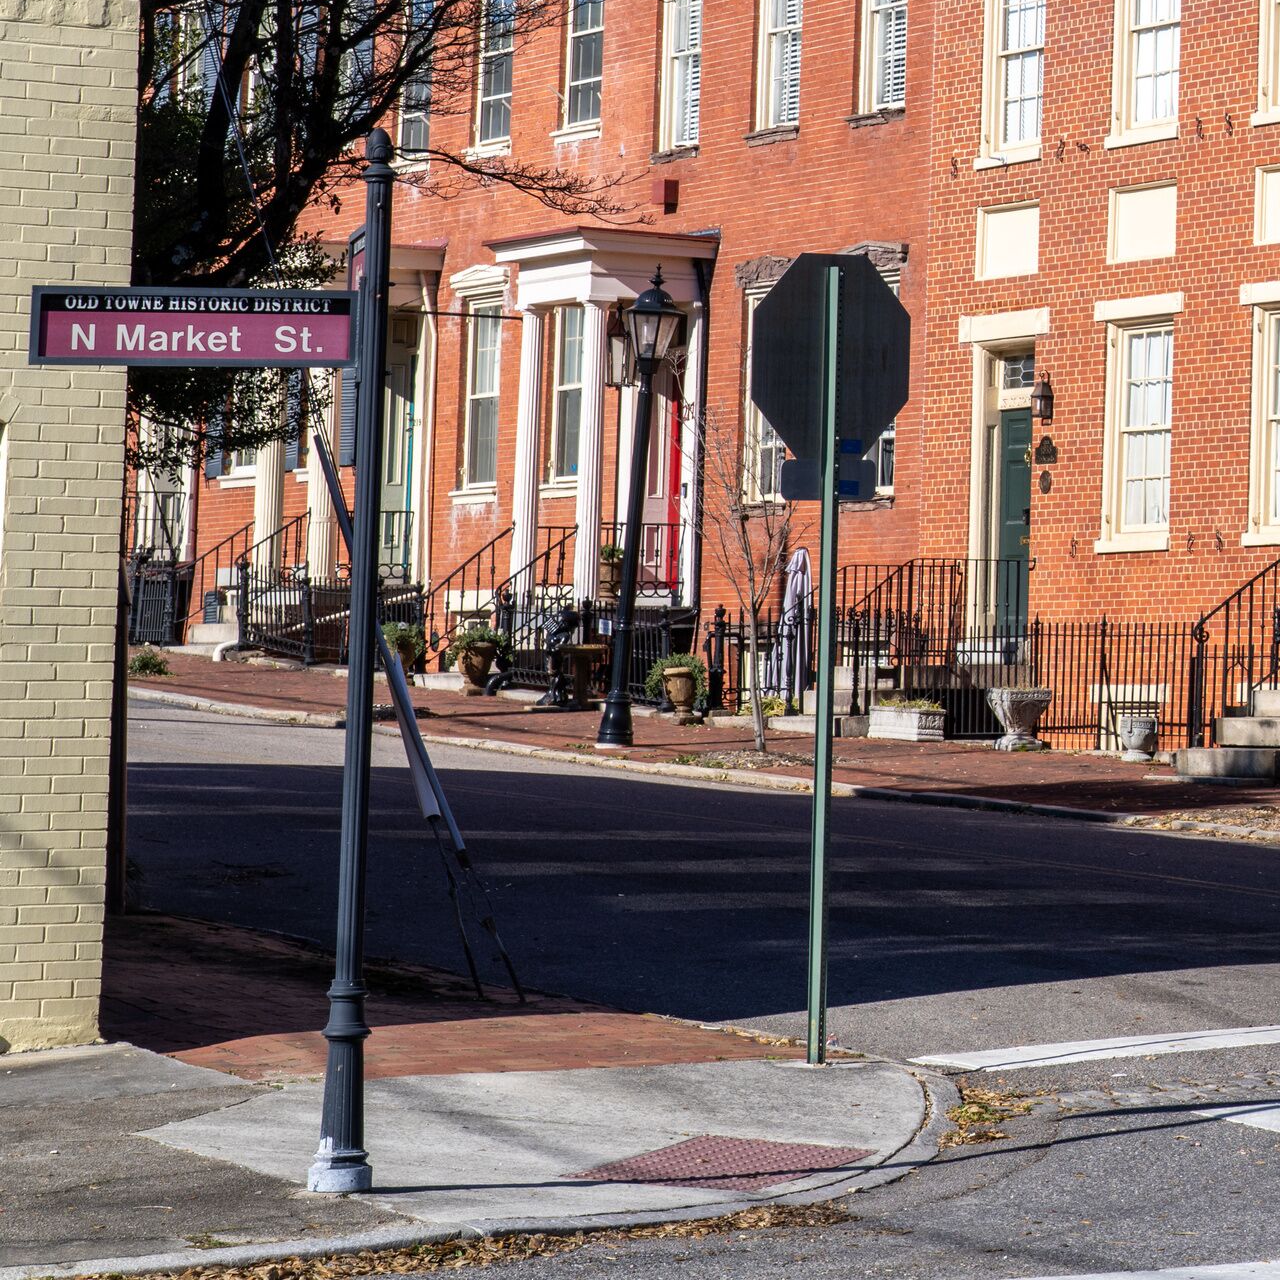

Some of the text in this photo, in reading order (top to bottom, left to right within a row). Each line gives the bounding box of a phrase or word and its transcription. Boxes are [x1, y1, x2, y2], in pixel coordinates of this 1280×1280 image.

[65, 295, 332, 313] OLD TOWNE HISTORIC DISTRICT
[71, 323, 324, 353] N Market St.
